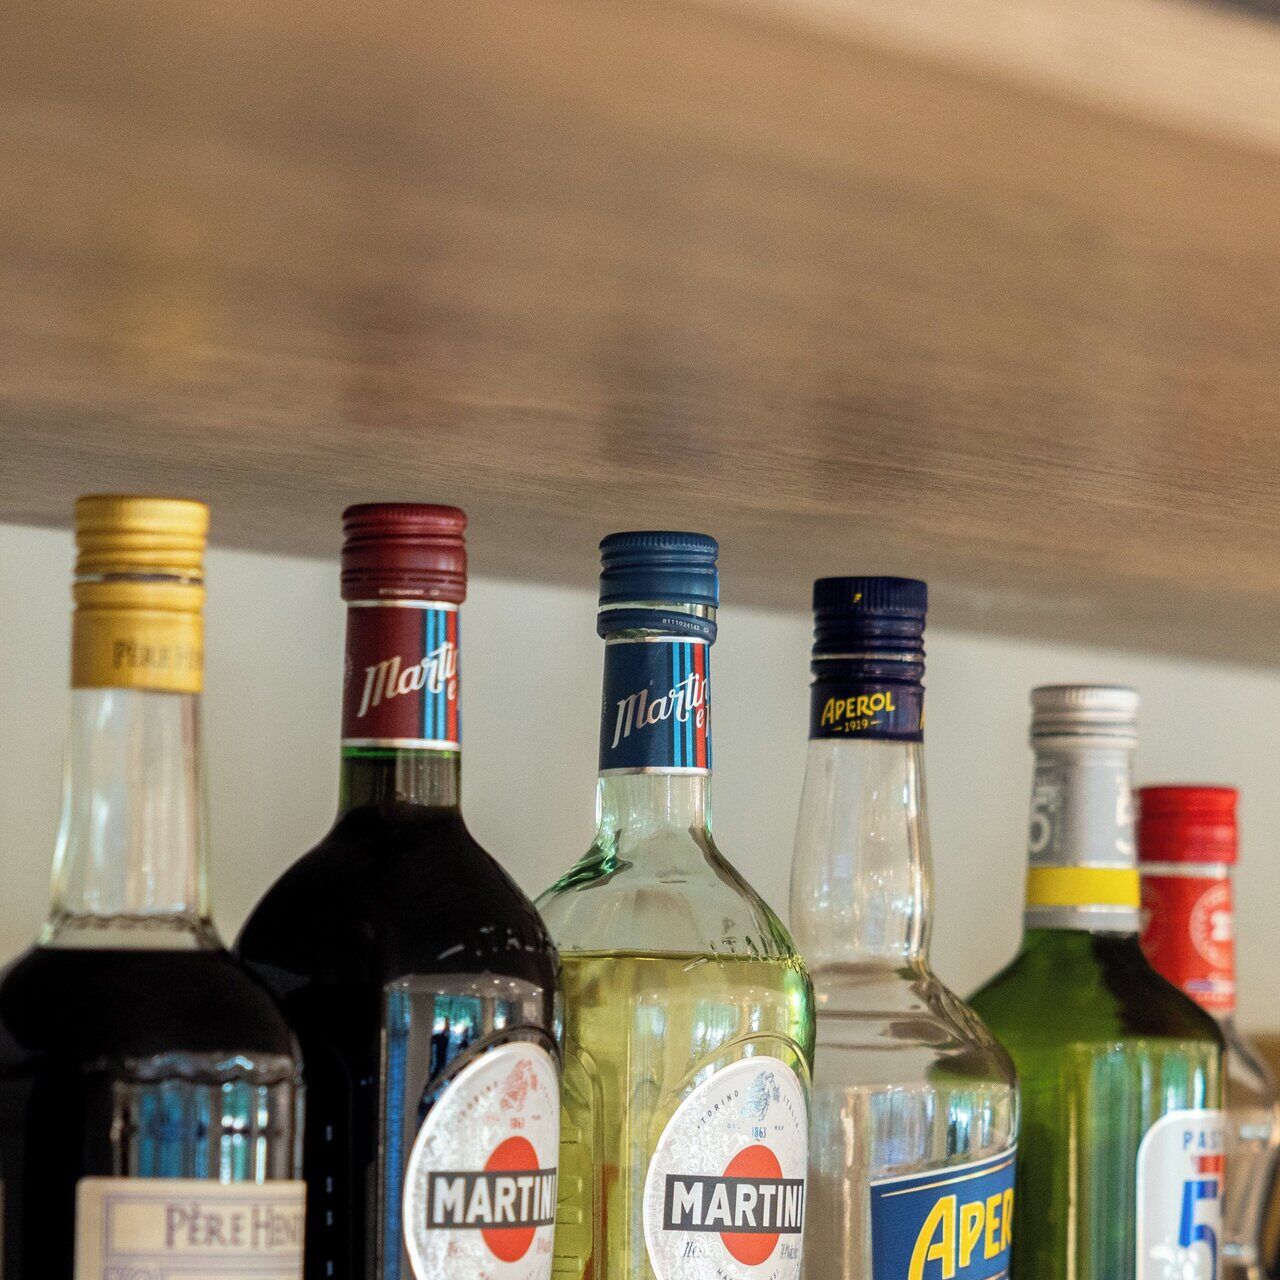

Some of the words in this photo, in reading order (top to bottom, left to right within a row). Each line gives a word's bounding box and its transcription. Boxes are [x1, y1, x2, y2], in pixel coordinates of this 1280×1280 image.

[820, 690, 896, 728] APEROL
[844, 718, 870, 733] 1919
[699, 1089, 740, 1125] TORINO
[751, 1126, 767, 1139] 1863
[671, 1181, 803, 1229] MARTINI
